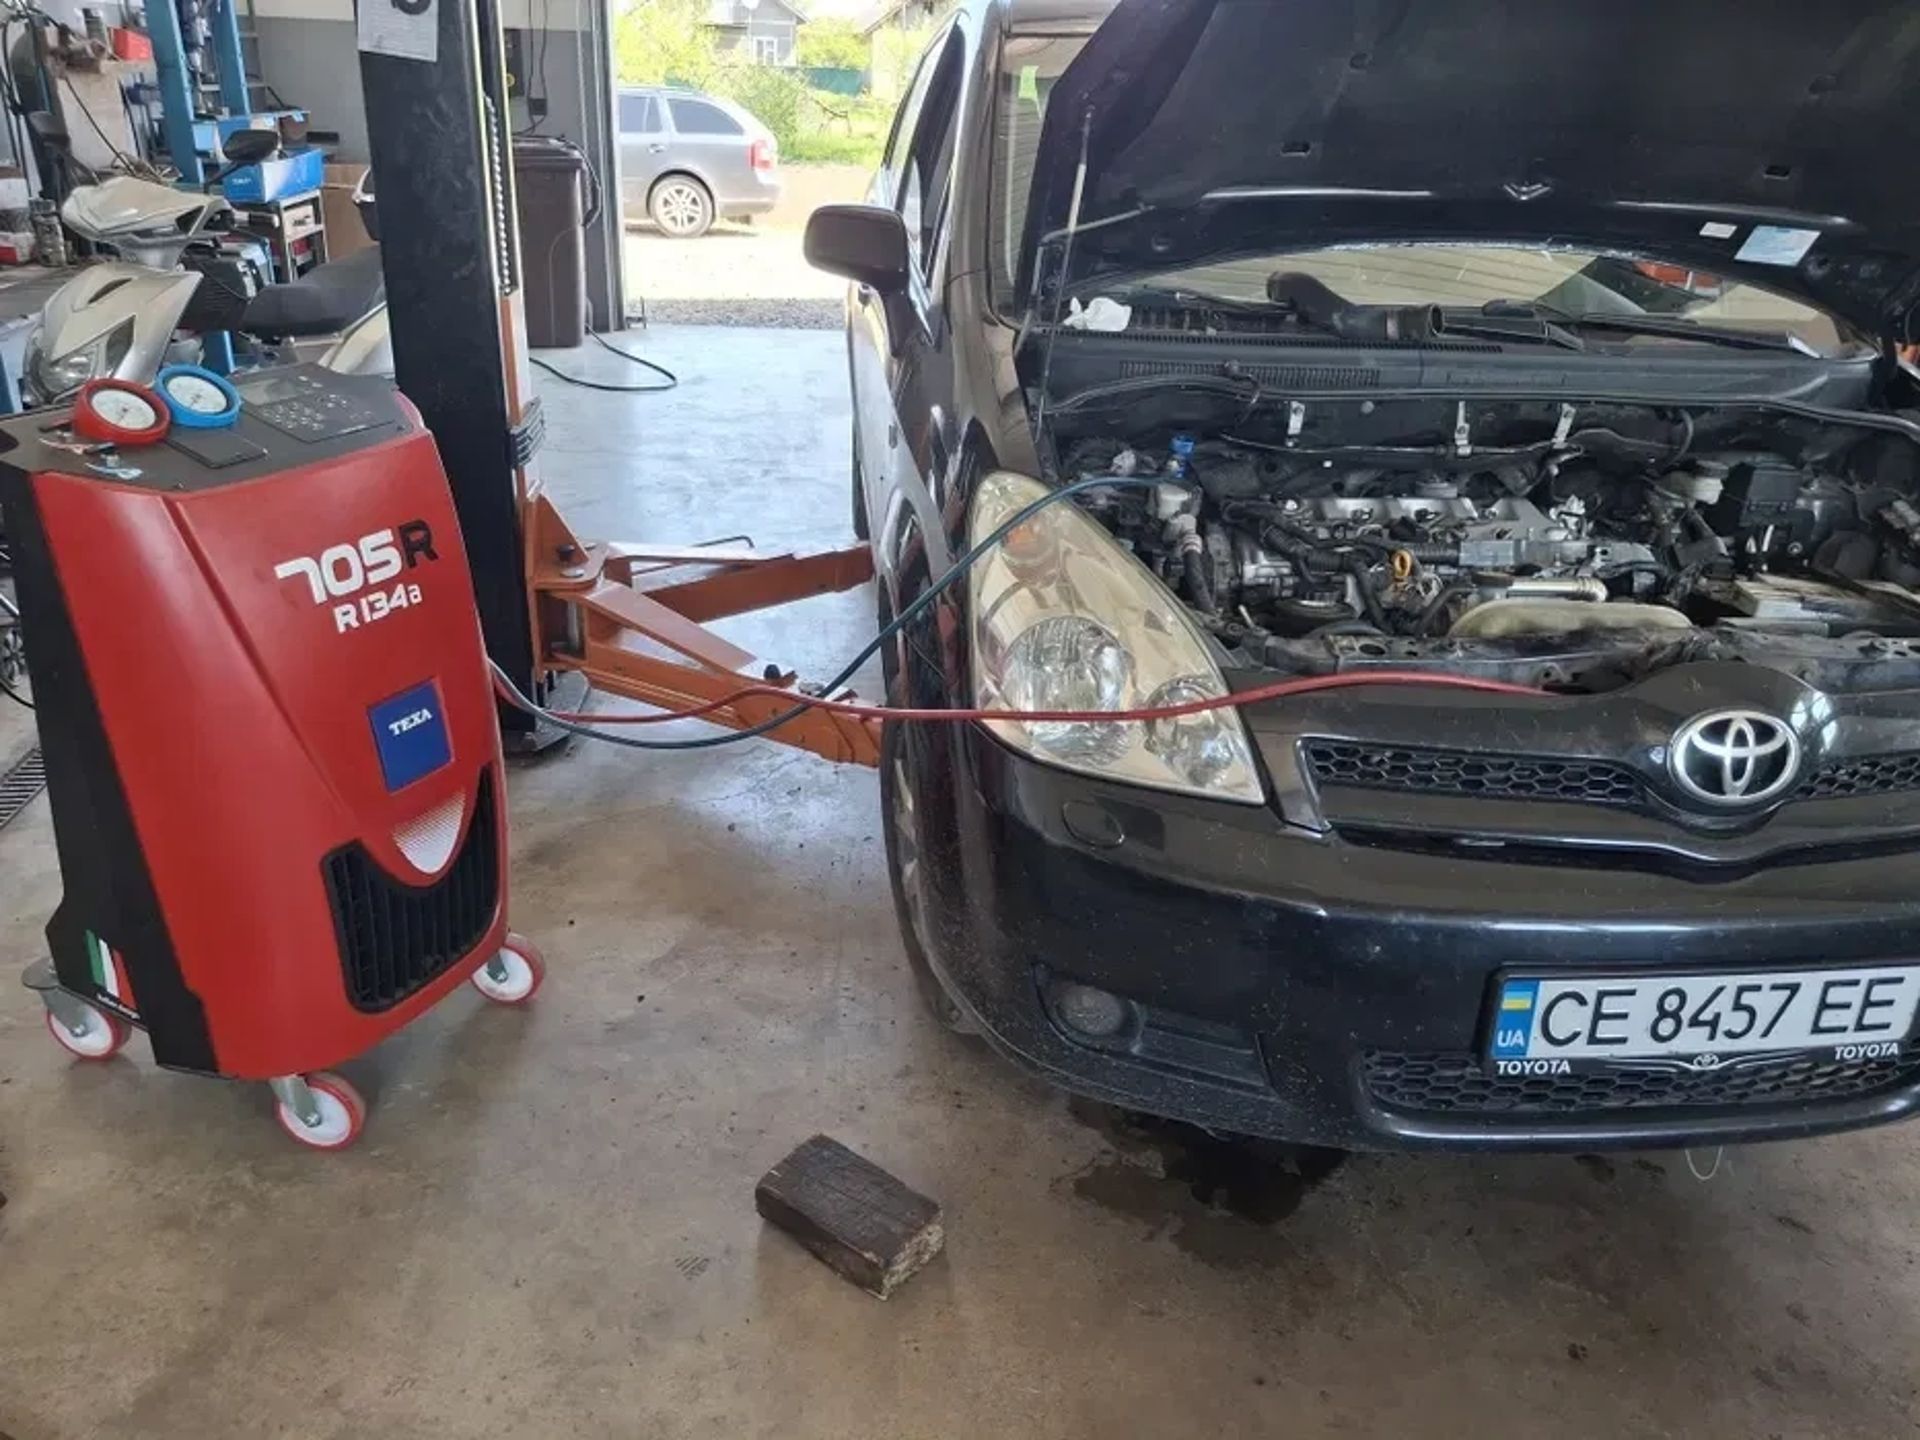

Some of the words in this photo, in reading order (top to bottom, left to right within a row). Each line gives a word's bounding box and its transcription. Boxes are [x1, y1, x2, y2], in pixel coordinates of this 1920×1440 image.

[274, 520, 438, 604] 705R
[333, 583, 422, 633] R134a
[388, 708, 433, 736] TEXA
[1541, 988, 1637, 1047] CE
[1650, 982, 1802, 1044] 8457
[1810, 976, 1905, 1035] EE
[1497, 1028, 1525, 1047] UA
[1834, 1042, 1899, 1060] TOYOTA
[1496, 1060, 1571, 1075] TOYOTA
